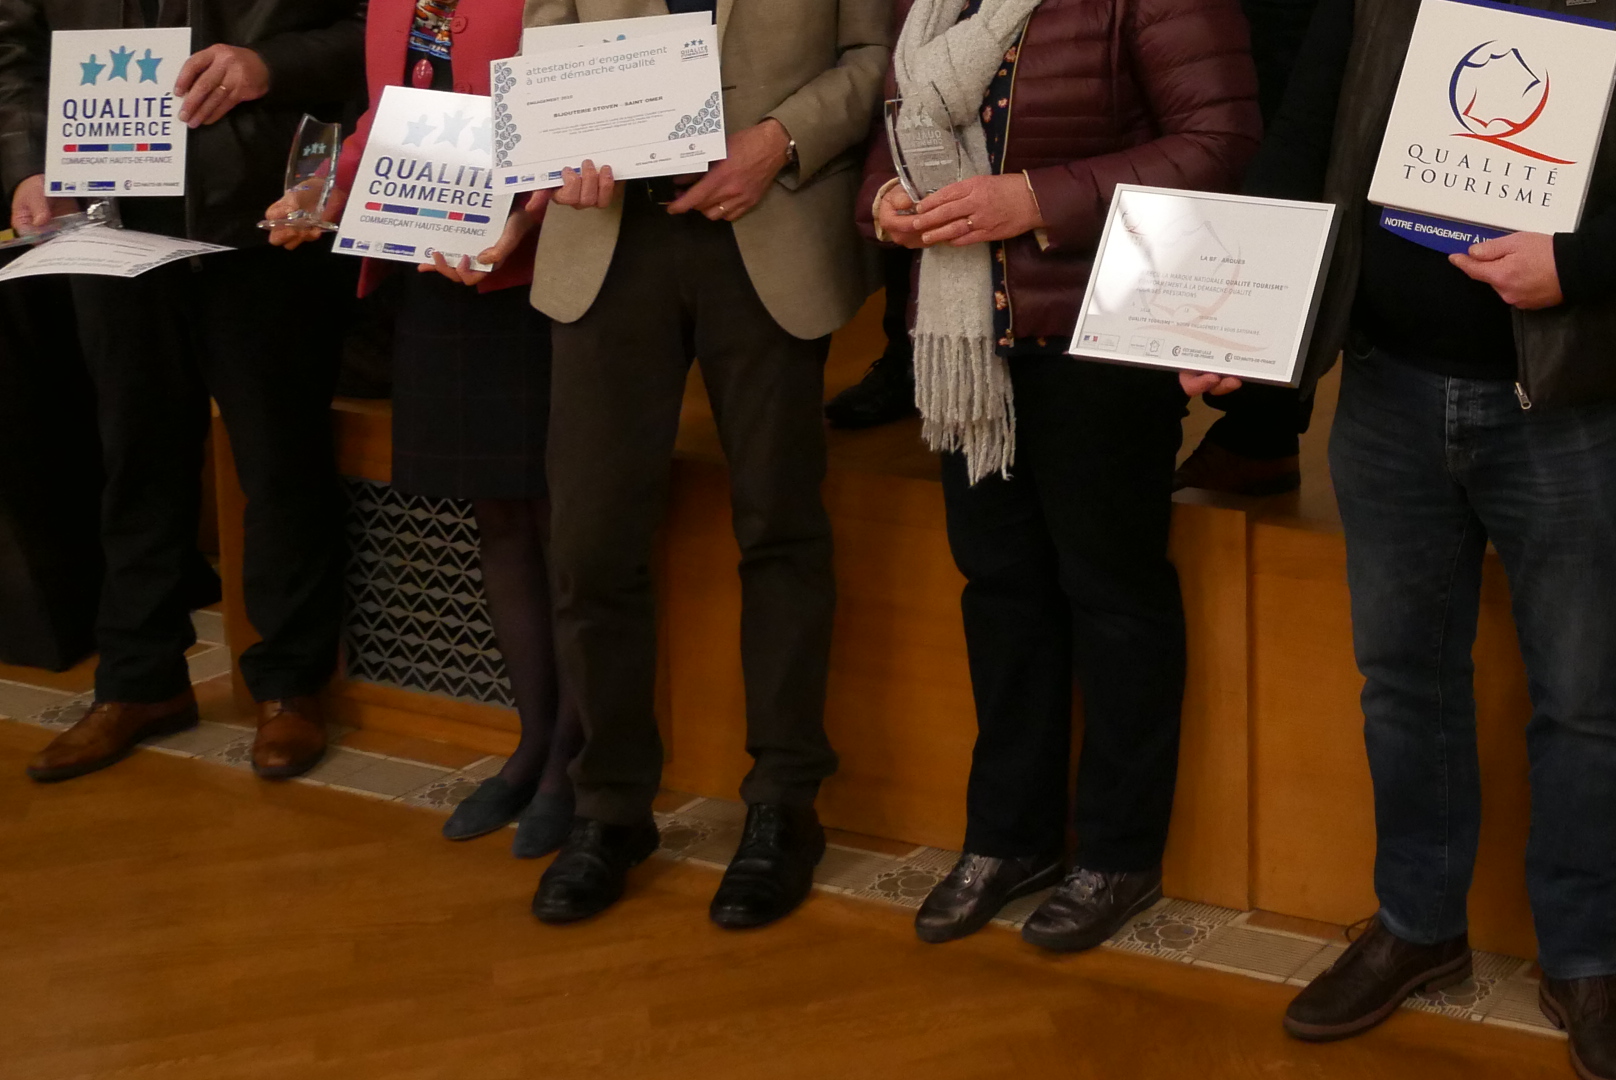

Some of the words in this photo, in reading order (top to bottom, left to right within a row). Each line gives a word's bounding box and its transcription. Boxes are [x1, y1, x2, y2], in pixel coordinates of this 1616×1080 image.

[526, 62, 585, 76] attestation
[588, 46, 667, 66] d'engagement
[526, 77, 532, 86] à
[537, 76, 557, 84] une
[560, 64, 615, 80] démarche
[618, 58, 656, 72] qualité
[63, 92, 174, 121] QUALITÉ
[553, 108, 591, 118] BIJOUTERIE
[624, 99, 643, 107] SAINT
[645, 95, 663, 103] OMER
[62, 121, 171, 137] COMMERCE
[1407, 143, 1558, 186] QUALITÉ
[368, 180, 493, 208] COMMERCE
[1403, 164, 1553, 208] TOURISME
[360, 215, 414, 229] COMMERÇANT
[415, 221, 487, 237] HAUTS-DE-FRANCE
[1384, 216, 1413, 230] NOTRE
[1414, 223, 1472, 242] ENGAGEMENT
[1472, 234, 1480, 244] À
[1194, 276, 1224, 285] NATIONALE
[1225, 279, 1250, 288] QUALITÉ
